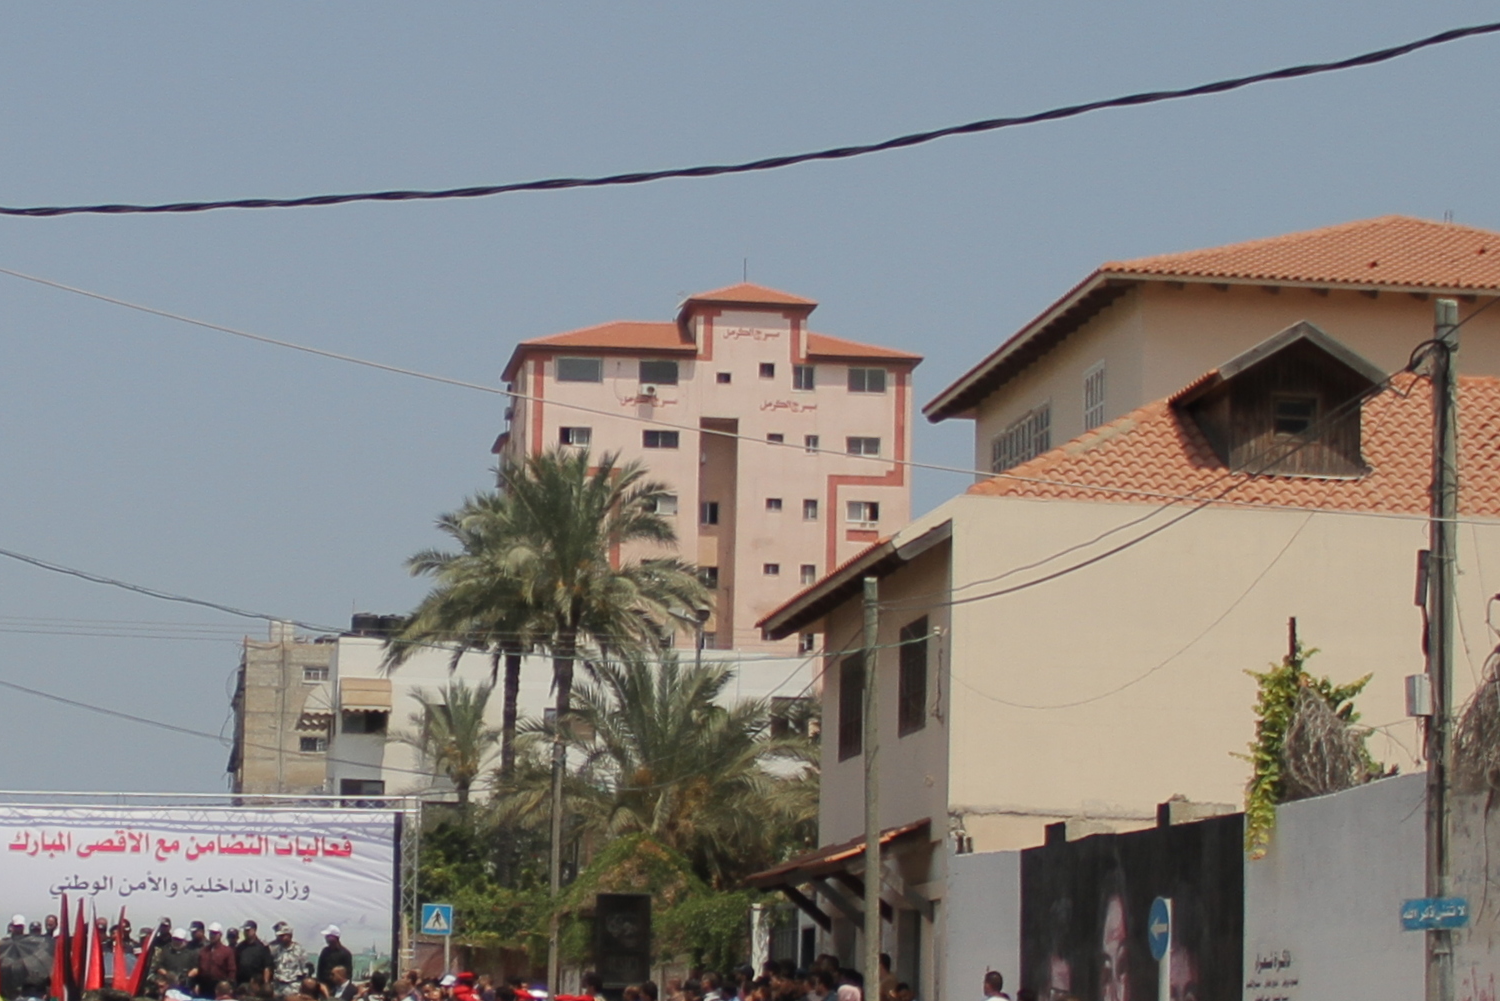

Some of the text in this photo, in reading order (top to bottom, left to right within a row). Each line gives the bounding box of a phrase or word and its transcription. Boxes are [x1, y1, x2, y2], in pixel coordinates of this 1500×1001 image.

[8, 831, 71, 857] المبارك
[155, 837, 180, 861] مع
[185, 834, 269, 860] التضامن
[274, 834, 352, 863] فعاليات
[49, 871, 310, 900] وزارة الداخلية والأمن الوطني
